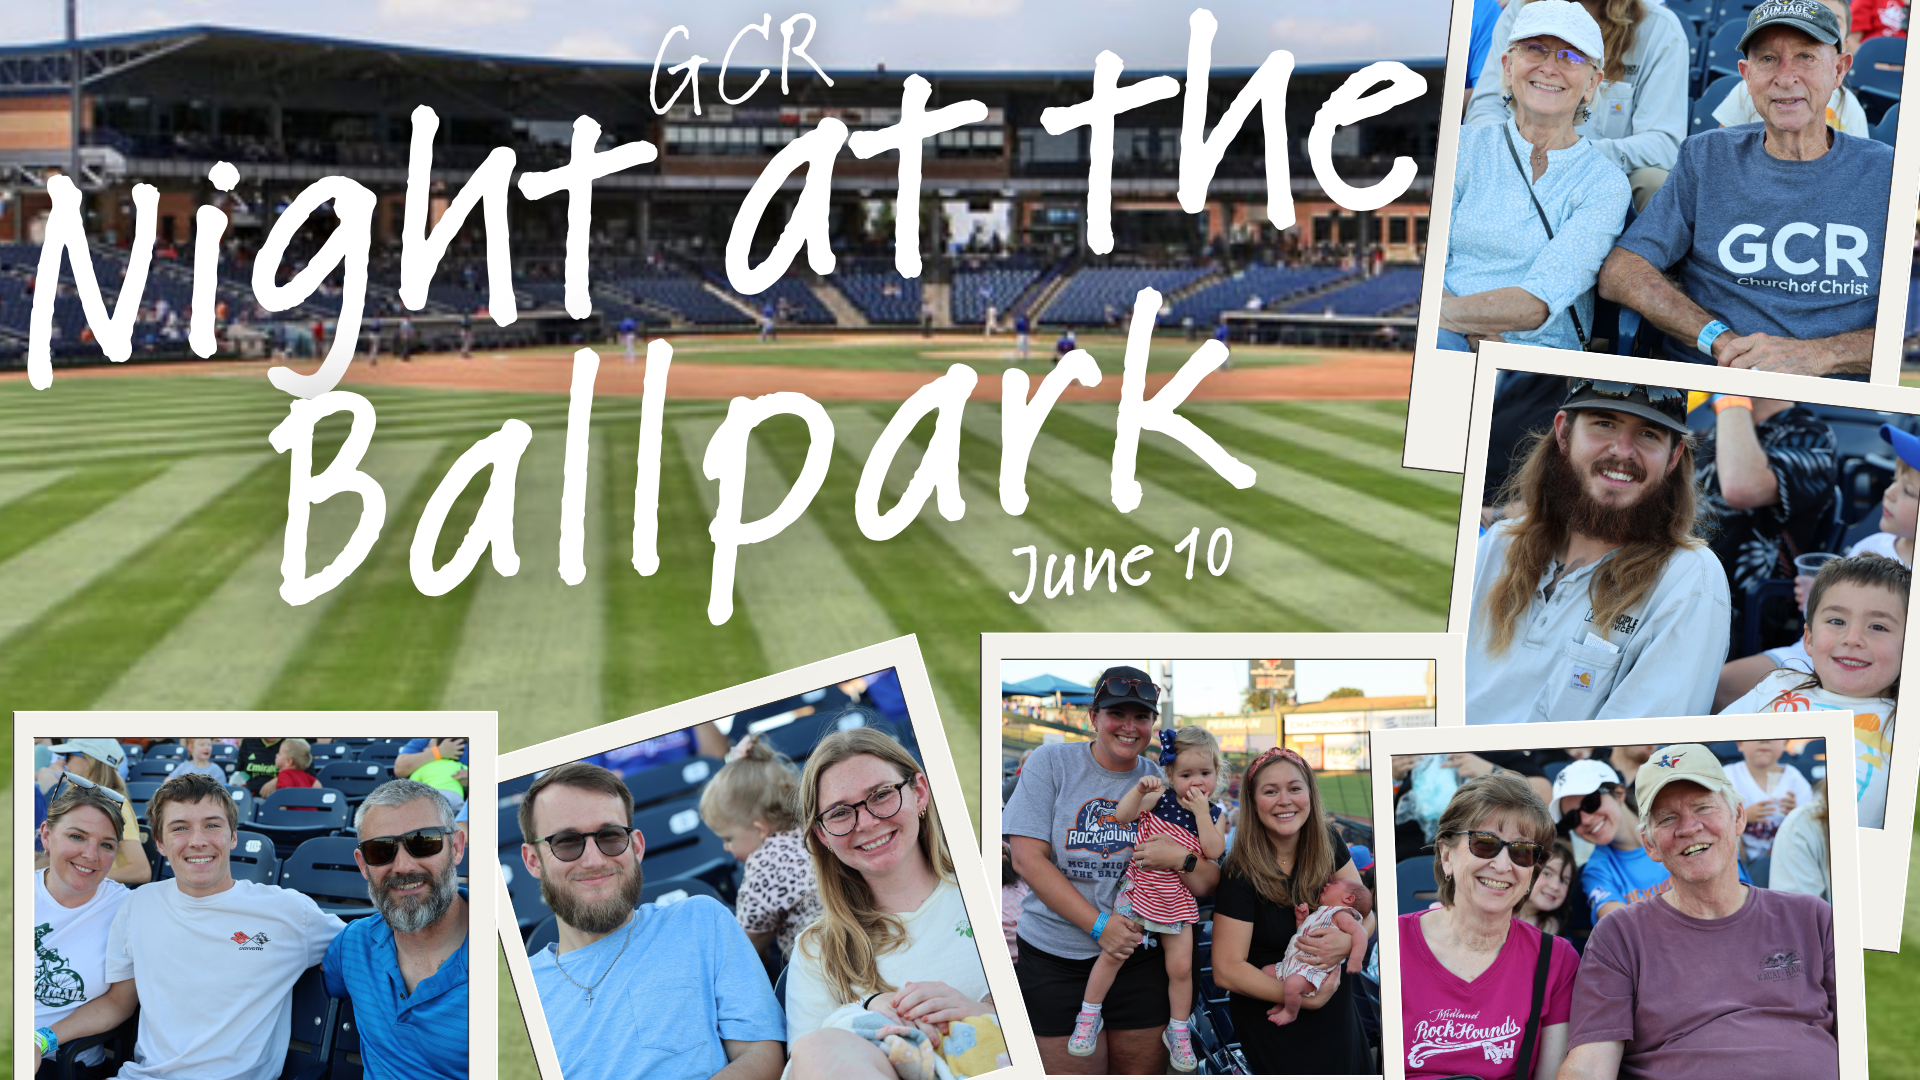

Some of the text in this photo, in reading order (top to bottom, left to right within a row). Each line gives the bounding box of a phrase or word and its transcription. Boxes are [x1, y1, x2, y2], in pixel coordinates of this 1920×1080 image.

[1763, 4, 1809, 16] VINTAGE
[1717, 221, 1869, 278] GCR
[1736, 277, 1869, 296] Church of Christ
[1206, 717, 1261, 730] PERMIAN
[1068, 830, 1137, 845] ROCKHOUND
[248, 841, 259, 851] 10
[1067, 860, 1098, 870] MCRC
[1072, 870, 1093, 879] THE
[1757, 970, 1781, 981] KAUAI
[1429, 1007, 1480, 1023] Midland
